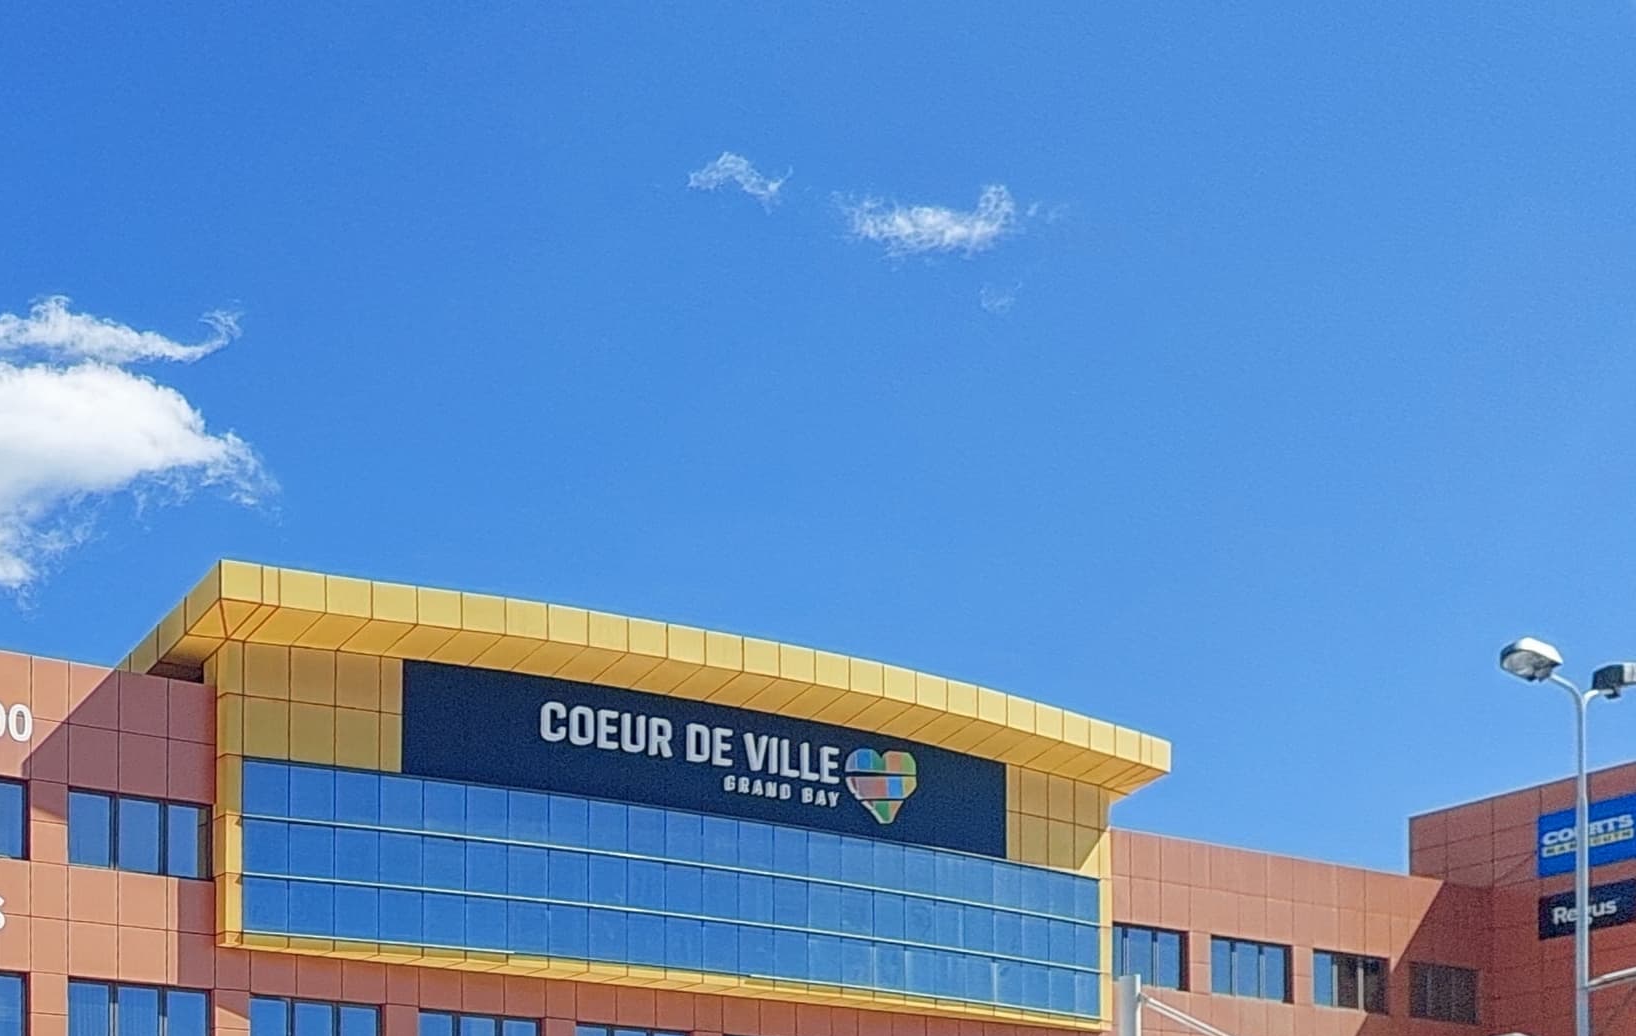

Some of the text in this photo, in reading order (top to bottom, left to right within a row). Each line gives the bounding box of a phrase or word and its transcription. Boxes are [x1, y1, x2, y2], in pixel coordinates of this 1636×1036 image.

[540, 701, 841, 784] COEUR DE VILLE
[724, 774, 841, 808] GRAND BAY
[1542, 814, 1635, 846] CORTS
[1552, 900, 1617, 925] Reus
